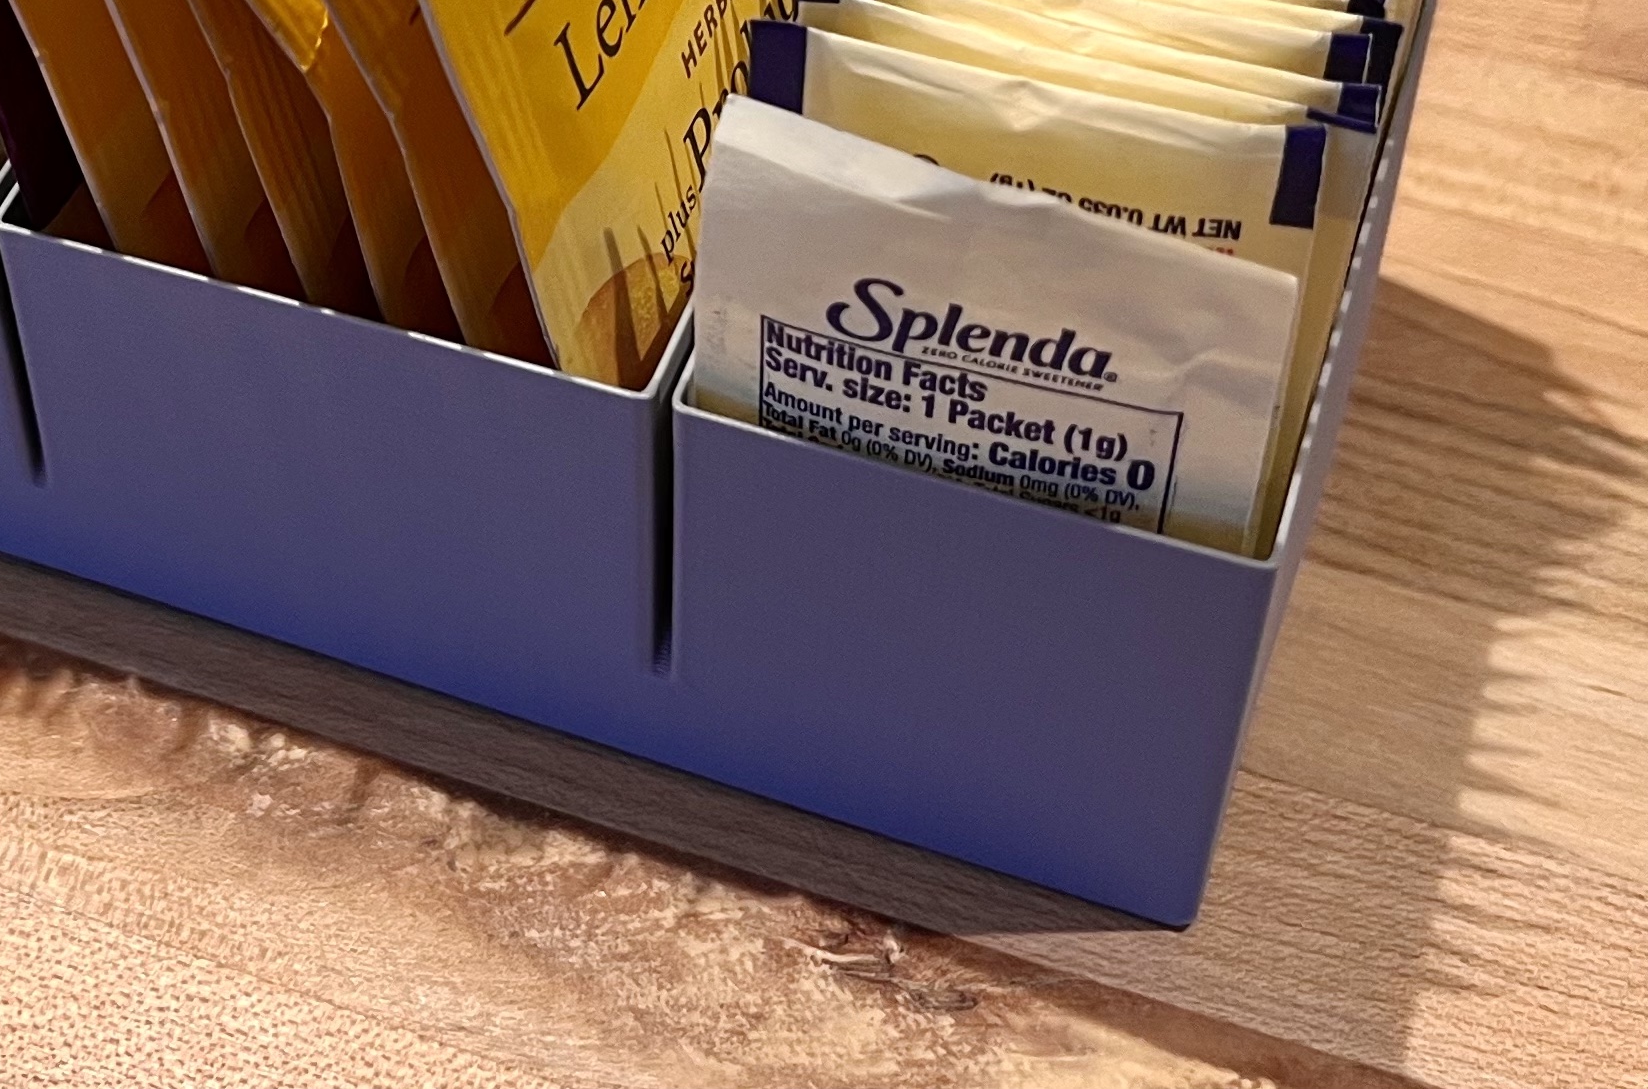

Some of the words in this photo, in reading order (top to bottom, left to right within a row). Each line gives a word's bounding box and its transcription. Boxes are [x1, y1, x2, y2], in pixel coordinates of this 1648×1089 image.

[660, 184, 698, 267] plus
[1148, 213, 1186, 239] WT
[1191, 217, 1242, 241] NET
[766, 322, 893, 381] Nutrition
[902, 361, 989, 403] Facts
[921, 346, 958, 361] ZERO
[961, 353, 1019, 374] CALORIE
[1021, 367, 1105, 392] SWEETENER
[764, 381, 843, 425] Amount
[848, 414, 884, 438] per
[888, 426, 980, 461] serving:
[988, 441, 1117, 486] Calories
[1126, 459, 1156, 491] 0
[765, 346, 833, 392] Serv.
[843, 376, 912, 413] size:
[921, 394, 935, 418] 1
[948, 398, 1055, 445] Packet
[1064, 423, 1128, 462] (1g)
[762, 400, 804, 429] Total
[808, 419, 838, 441] Fat
[866, 437, 899, 461] (0%
[942, 457, 1015, 487] Sodium
[1019, 474, 1059, 499] 0mg
[1064, 482, 1099, 503] (0%
[1105, 489, 1140, 511] DV),
